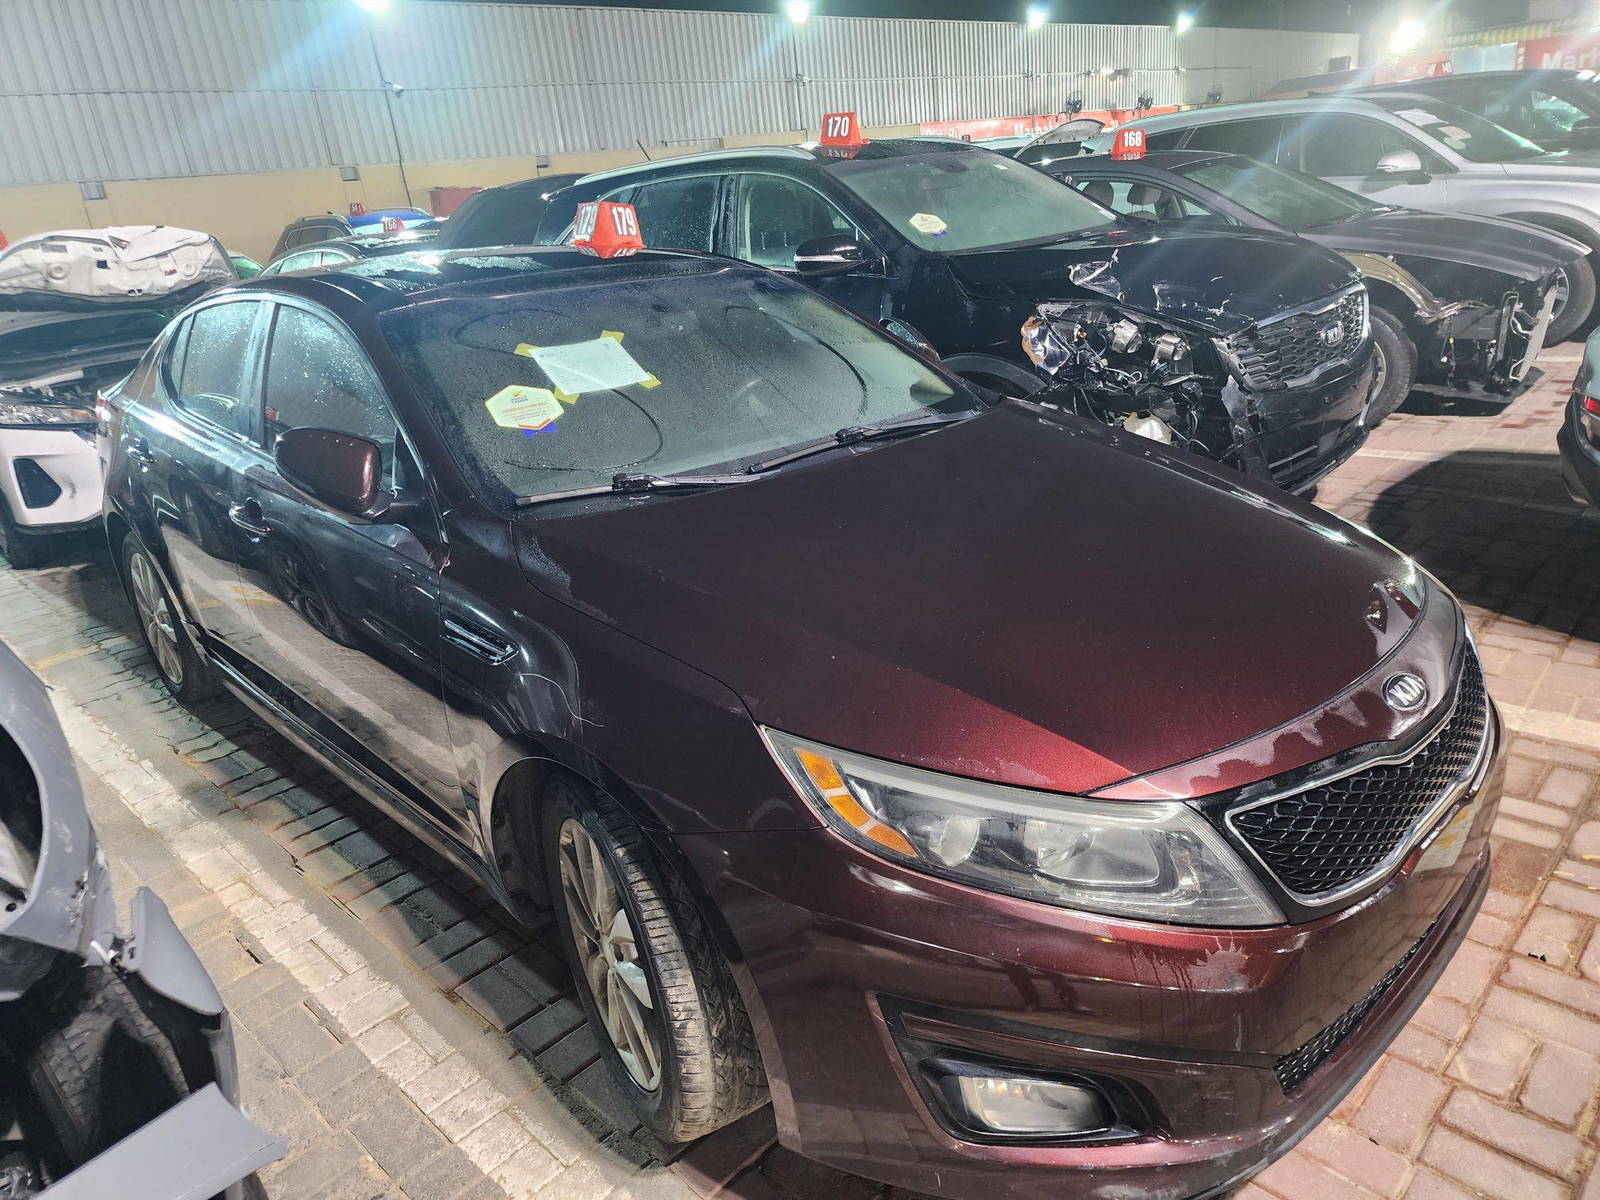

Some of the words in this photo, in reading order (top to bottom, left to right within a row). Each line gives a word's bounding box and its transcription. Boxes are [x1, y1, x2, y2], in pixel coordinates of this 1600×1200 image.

[828, 116, 850, 138] 170
[1123, 131, 1142, 148] 168
[578, 205, 598, 235] 179
[612, 206, 637, 236] 179
[1388, 676, 1425, 706] KIA
